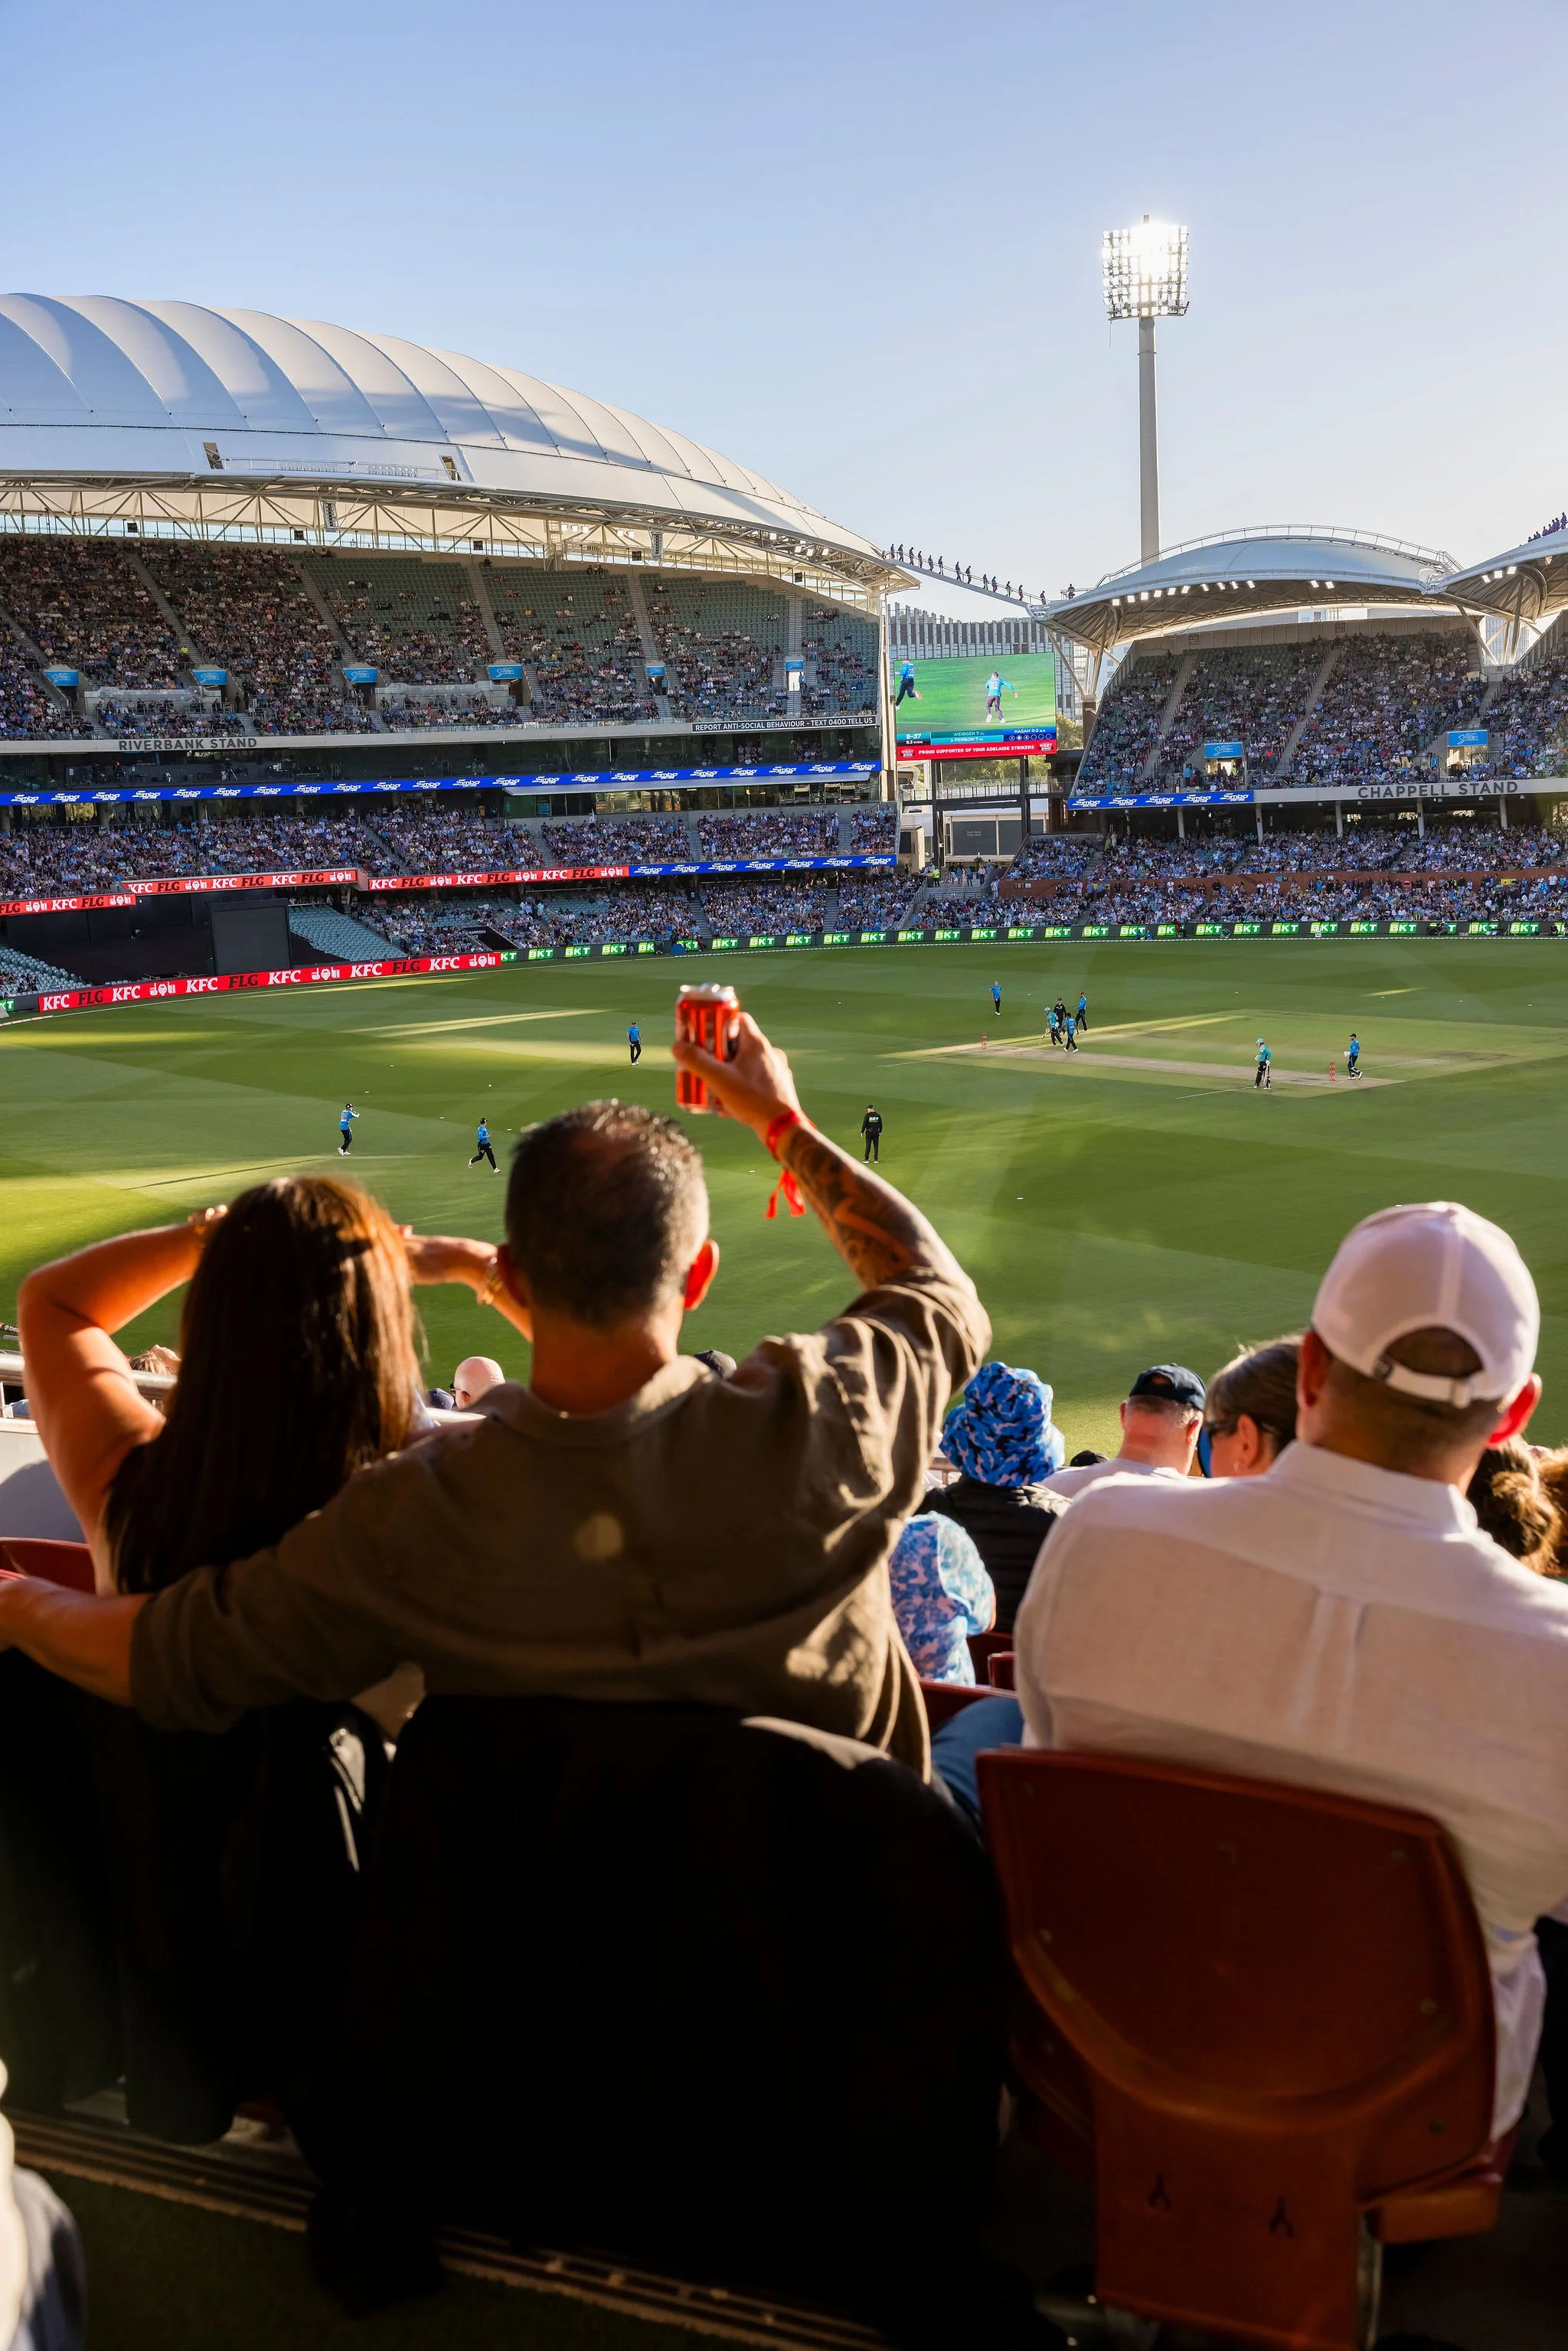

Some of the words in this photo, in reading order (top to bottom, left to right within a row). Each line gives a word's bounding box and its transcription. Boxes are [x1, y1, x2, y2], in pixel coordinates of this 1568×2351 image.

[119, 739, 204, 750] RIVERBANK
[211, 738, 257, 748] STAND
[1358, 785, 1449, 798] CHAPPELL
[1459, 781, 1518, 795] STAND
[129, 883, 152, 893] KFC
[158, 882, 179, 891] FLG
[212, 879, 237, 888] KFC
[242, 877, 263, 887] FLG
[271, 875, 296, 885] KFC
[301, 873, 324, 883] FLG
[371, 879, 397, 889] KFC
[401, 877, 424, 887] FLG
[456, 874, 482, 884] KFC
[486, 873, 509, 883] FLG
[542, 870, 568, 880] KFC
[572, 868, 595, 877] FLG
[51, 899, 77, 910] KFC
[81, 897, 103, 907] FLG
[529, 949, 552, 958] BKT
[566, 947, 589, 955] BKT
[603, 945, 626, 953] BKT
[899, 932, 923, 940] BKT
[972, 929, 995, 938] BKT
[1010, 929, 1033, 937] BKT
[1122, 926, 1145, 935] BKT
[1158, 926, 1175, 934] BK
[1197, 925, 1221, 933] BKT
[1236, 924, 1259, 932] BKT
[1273, 924, 1298, 932] BKT
[1312, 923, 1336, 932] BKT
[1352, 923, 1377, 932] BKT
[1392, 923, 1416, 932] BKT
[1512, 923, 1537, 932] BKT
[43, 994, 69, 1011] KFC
[78, 991, 103, 1005] FLG
[112, 986, 140, 1002] KFC
[185, 978, 218, 993] KFC
[229, 975, 258, 988] FLG
[268, 970, 301, 984] KFC
[351, 963, 383, 978] KFC
[392, 960, 420, 974] FLG
[429, 957, 459, 971] KFC
